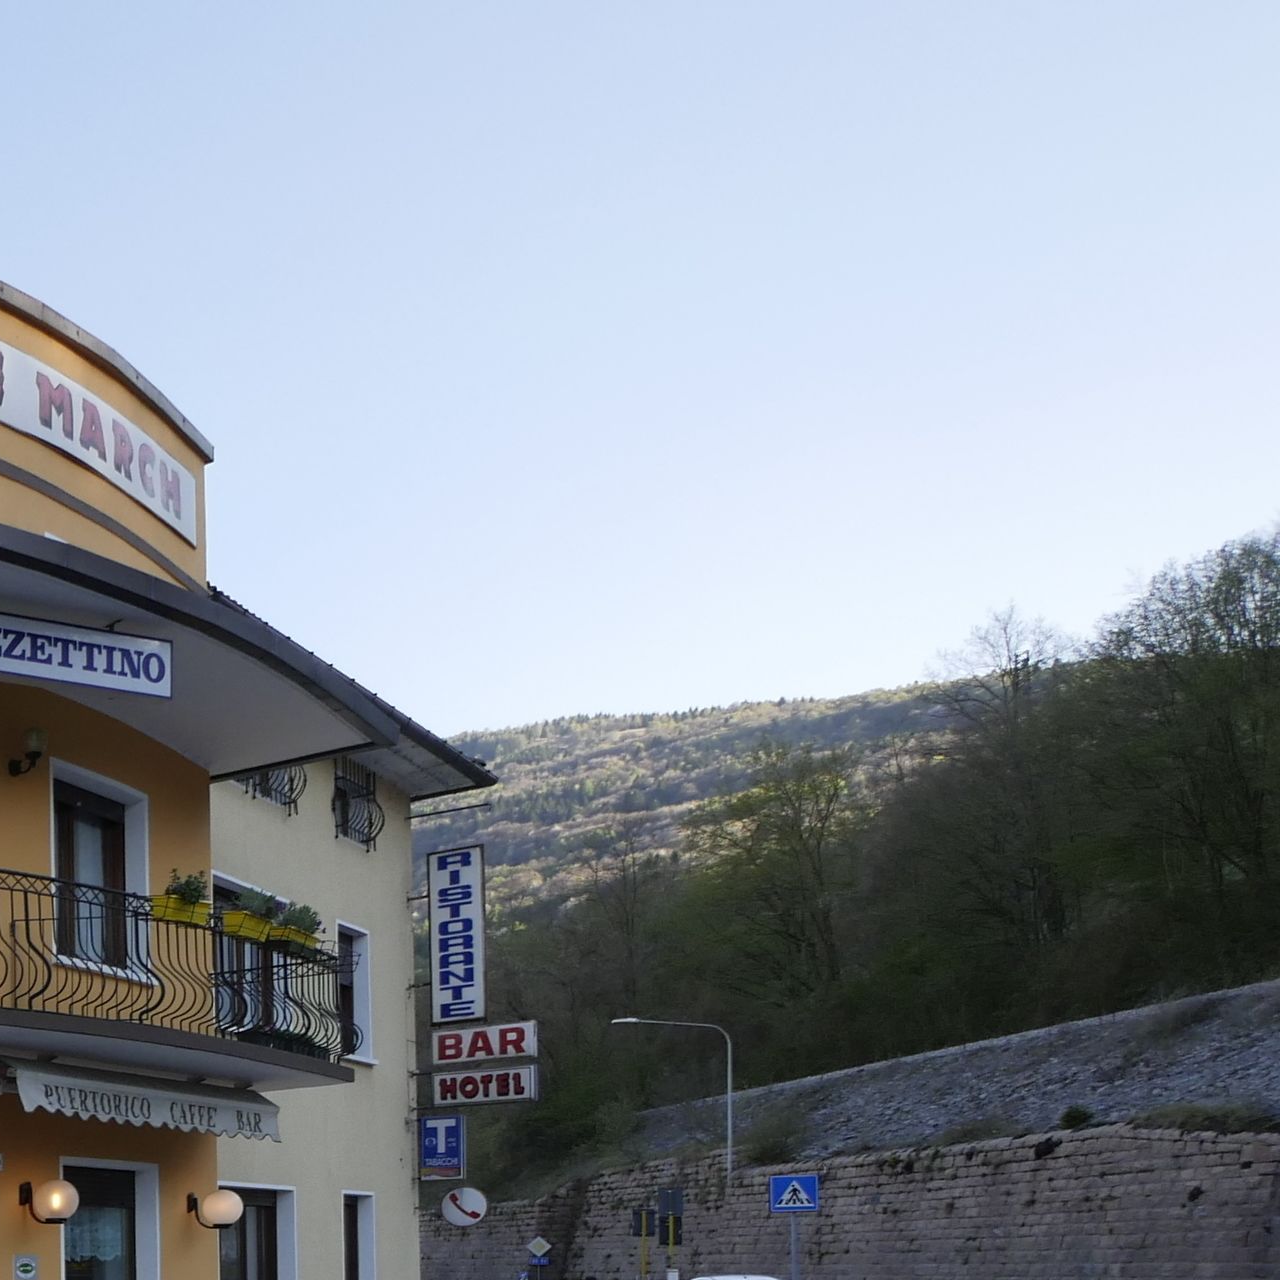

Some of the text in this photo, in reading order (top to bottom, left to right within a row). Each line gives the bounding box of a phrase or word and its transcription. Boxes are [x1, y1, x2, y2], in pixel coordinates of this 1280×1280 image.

[35, 371, 185, 522] MARCH
[436, 850, 476, 1019] RISTORANTE
[437, 1026, 527, 1061] BAR
[438, 1072, 525, 1101] HOTEL
[43, 1084, 151, 1119] PUERTORICO
[235, 1109, 262, 1133] BAR
[426, 1118, 457, 1154] T
